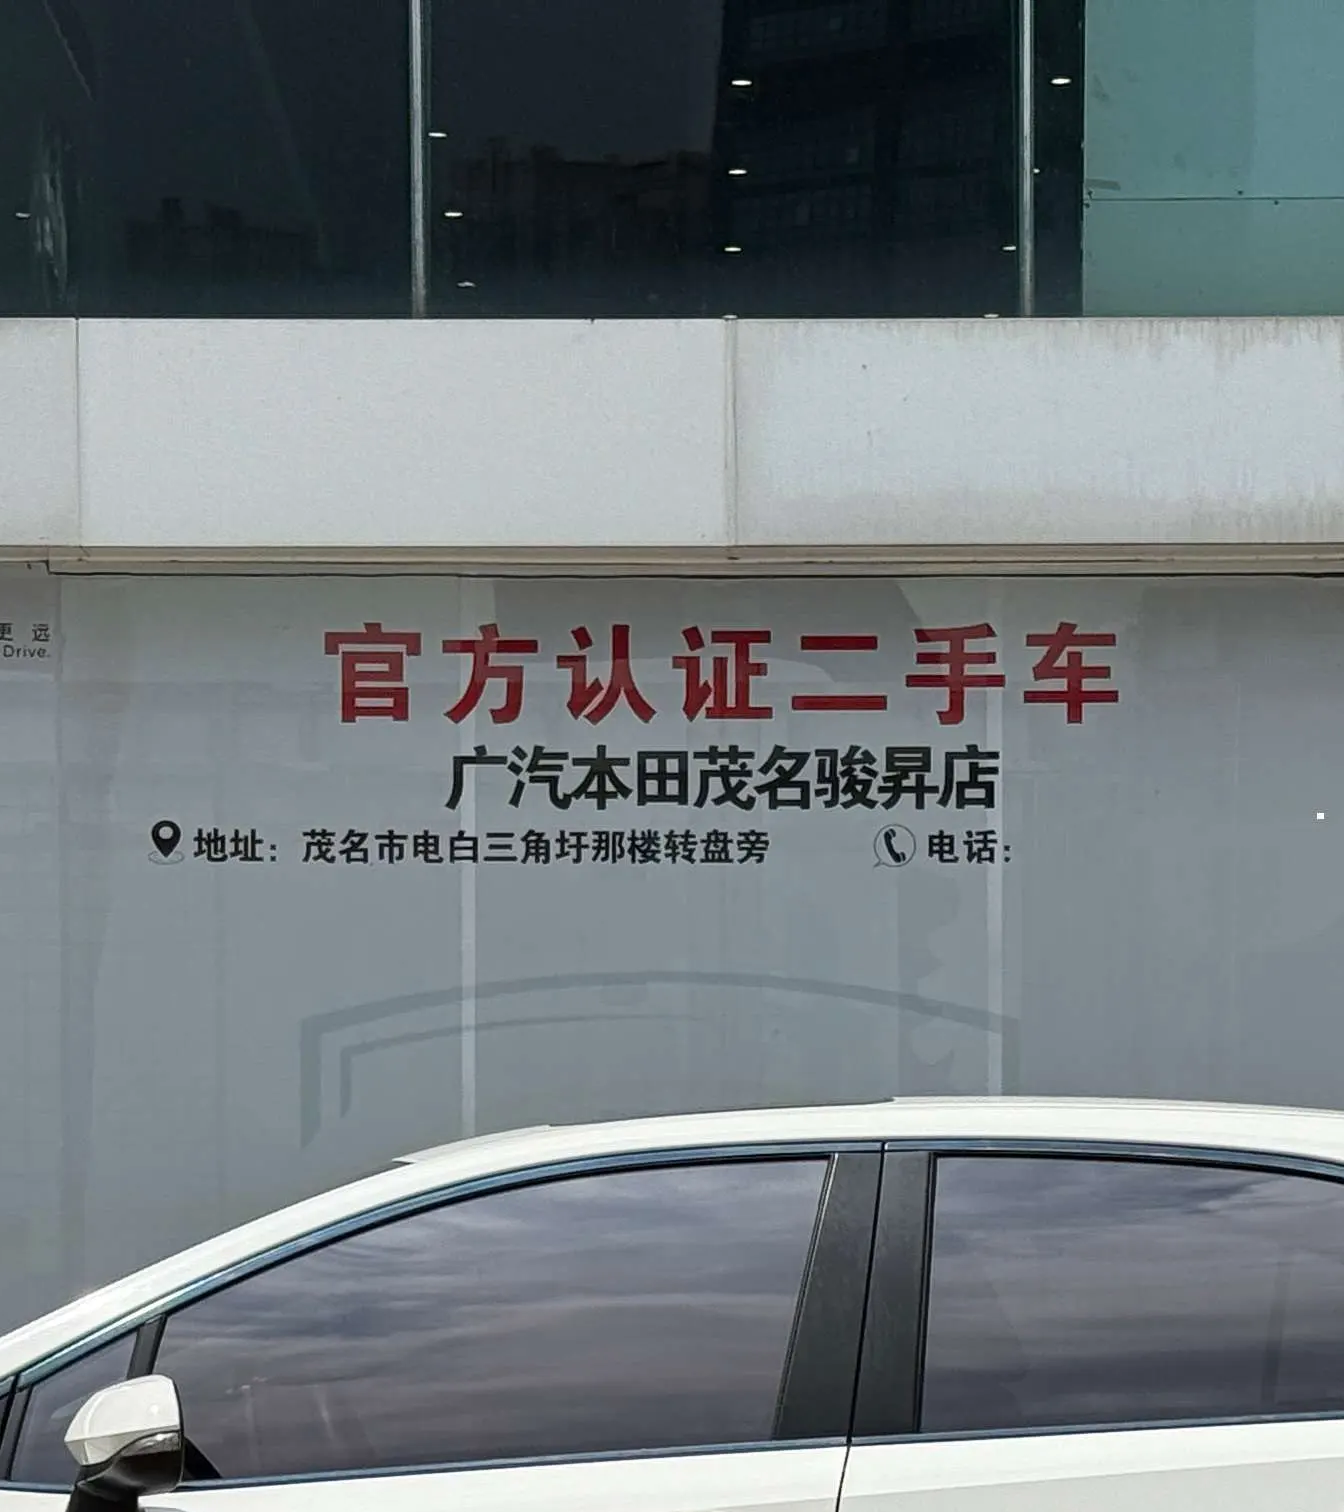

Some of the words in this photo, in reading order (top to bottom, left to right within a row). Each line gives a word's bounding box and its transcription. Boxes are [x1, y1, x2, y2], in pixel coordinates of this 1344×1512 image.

[3, 644, 52, 658] Drive.
[326, 624, 1120, 726] 官方认证二手车
[445, 744, 1001, 813] 广汽本田茂名骏昇店
[302, 829, 771, 866] 茂名市电白三角圩那楼转盘旁
